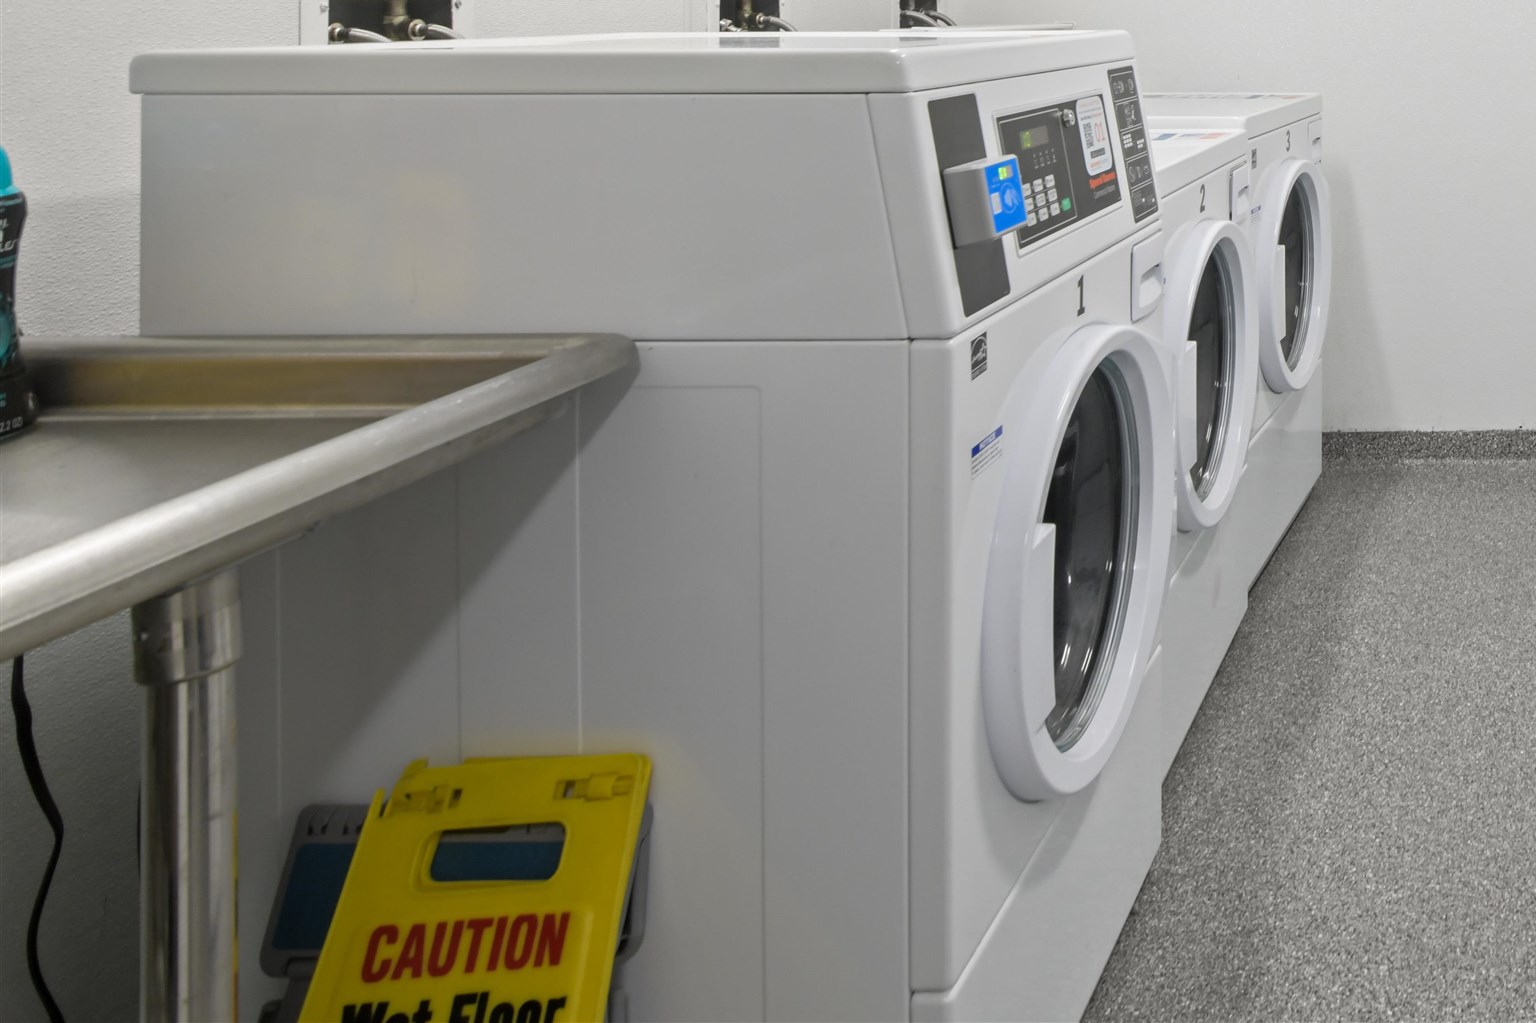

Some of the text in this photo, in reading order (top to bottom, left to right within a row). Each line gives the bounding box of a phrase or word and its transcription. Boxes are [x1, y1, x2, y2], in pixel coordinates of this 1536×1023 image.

[1286, 130, 1291, 152] 3
[1200, 184, 1205, 213] 2
[1077, 274, 1085, 317] 1
[360, 912, 571, 984] CAUTION
[341, 999, 434, 1023] Wt
